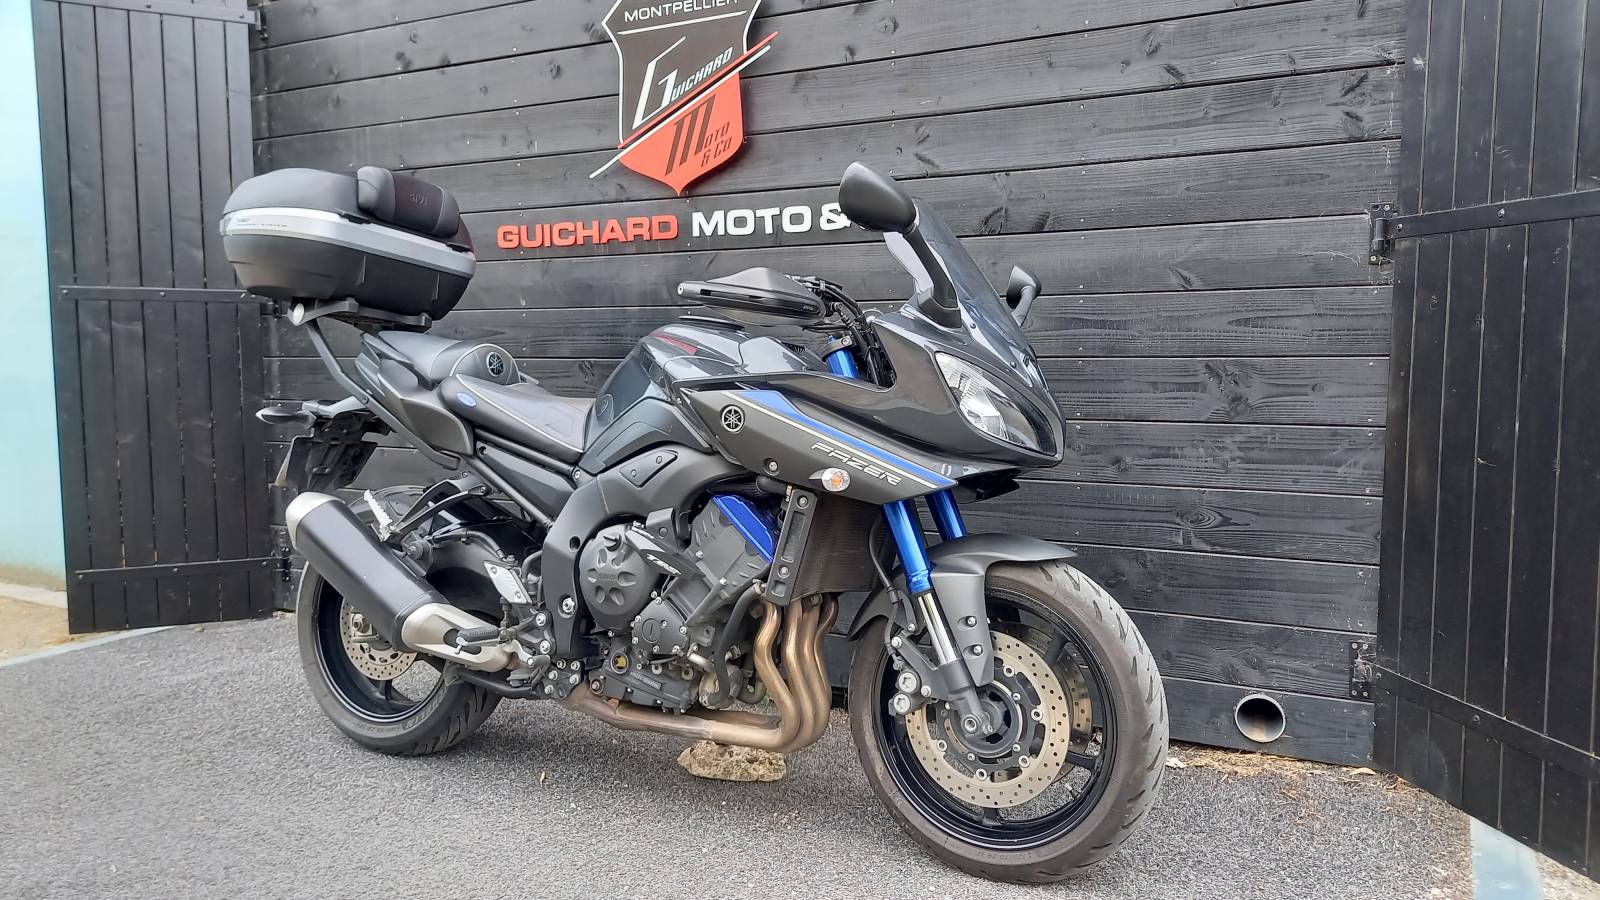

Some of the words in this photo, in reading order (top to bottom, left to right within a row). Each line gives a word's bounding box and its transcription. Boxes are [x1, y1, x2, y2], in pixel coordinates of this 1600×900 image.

[632, 36, 734, 130] GUICHARD
[496, 214, 679, 249] GUICHARD
[691, 205, 812, 237] MOTO
[819, 202, 852, 231] &
[810, 442, 902, 486] FAZER
